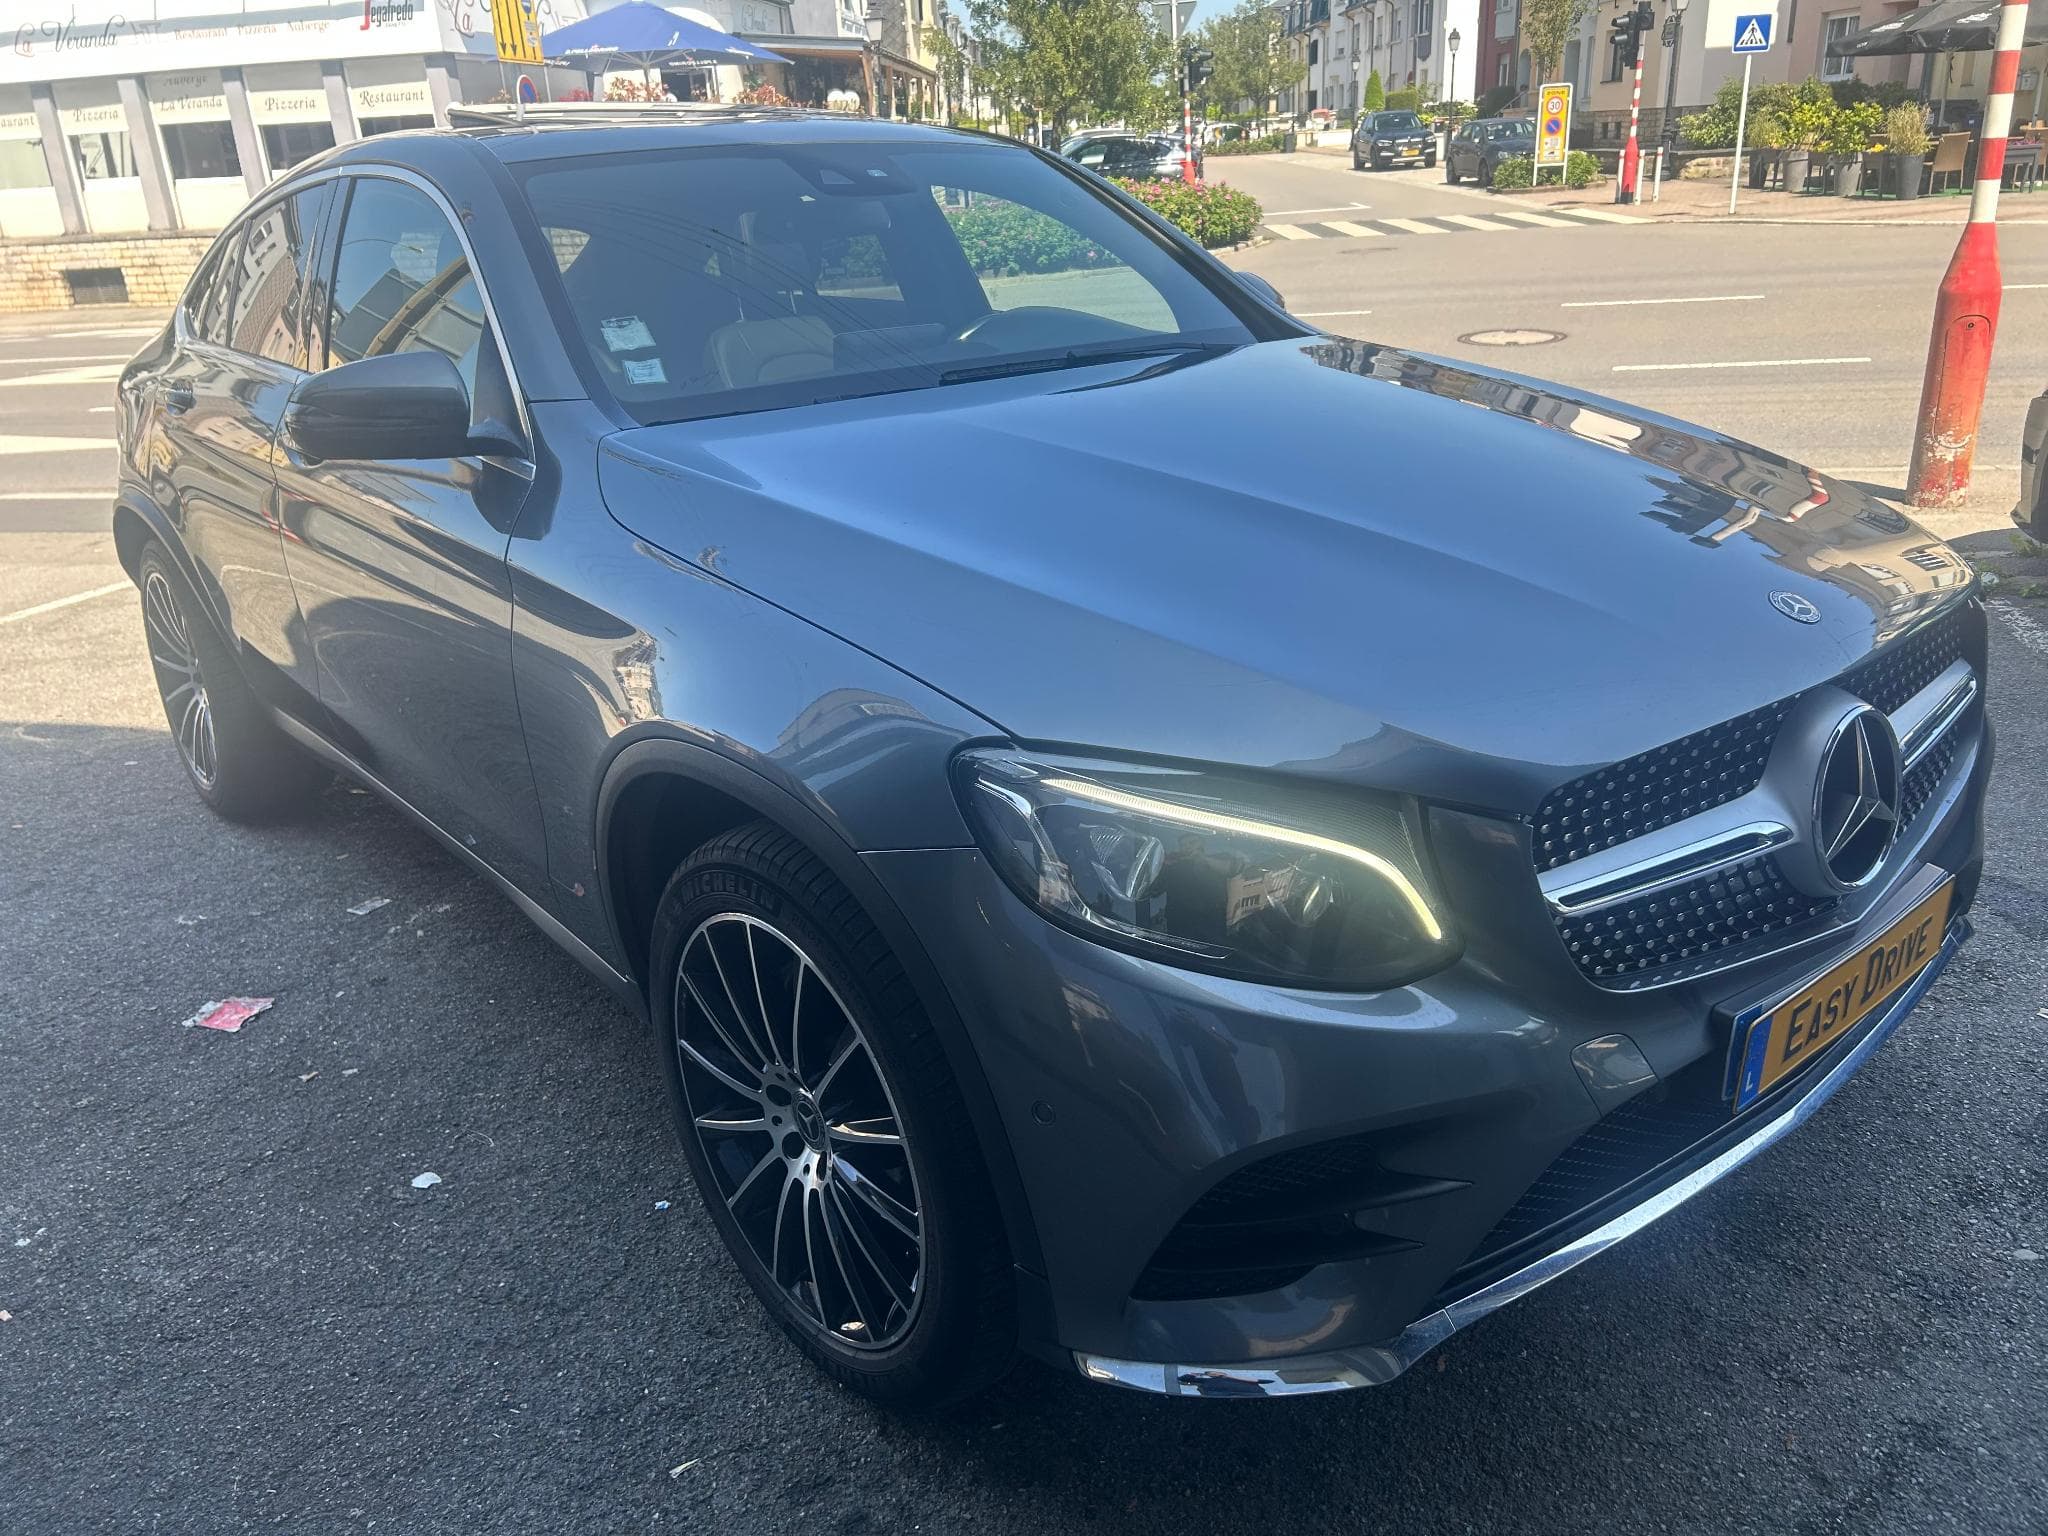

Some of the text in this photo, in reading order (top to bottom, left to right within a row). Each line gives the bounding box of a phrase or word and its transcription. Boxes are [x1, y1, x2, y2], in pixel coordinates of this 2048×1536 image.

[15, 14, 126, 57] La Veranda
[160, 94, 223, 112] La Veranda
[264, 97, 317, 112] Pizzeria
[360, 90, 425, 108] Restaurant
[1550, 101, 1561, 111] 30
[73, 107, 119, 122] Pizzeria
[680, 872, 775, 910] MICHELIN
[1782, 915, 1933, 1063] EASY DRIVE
